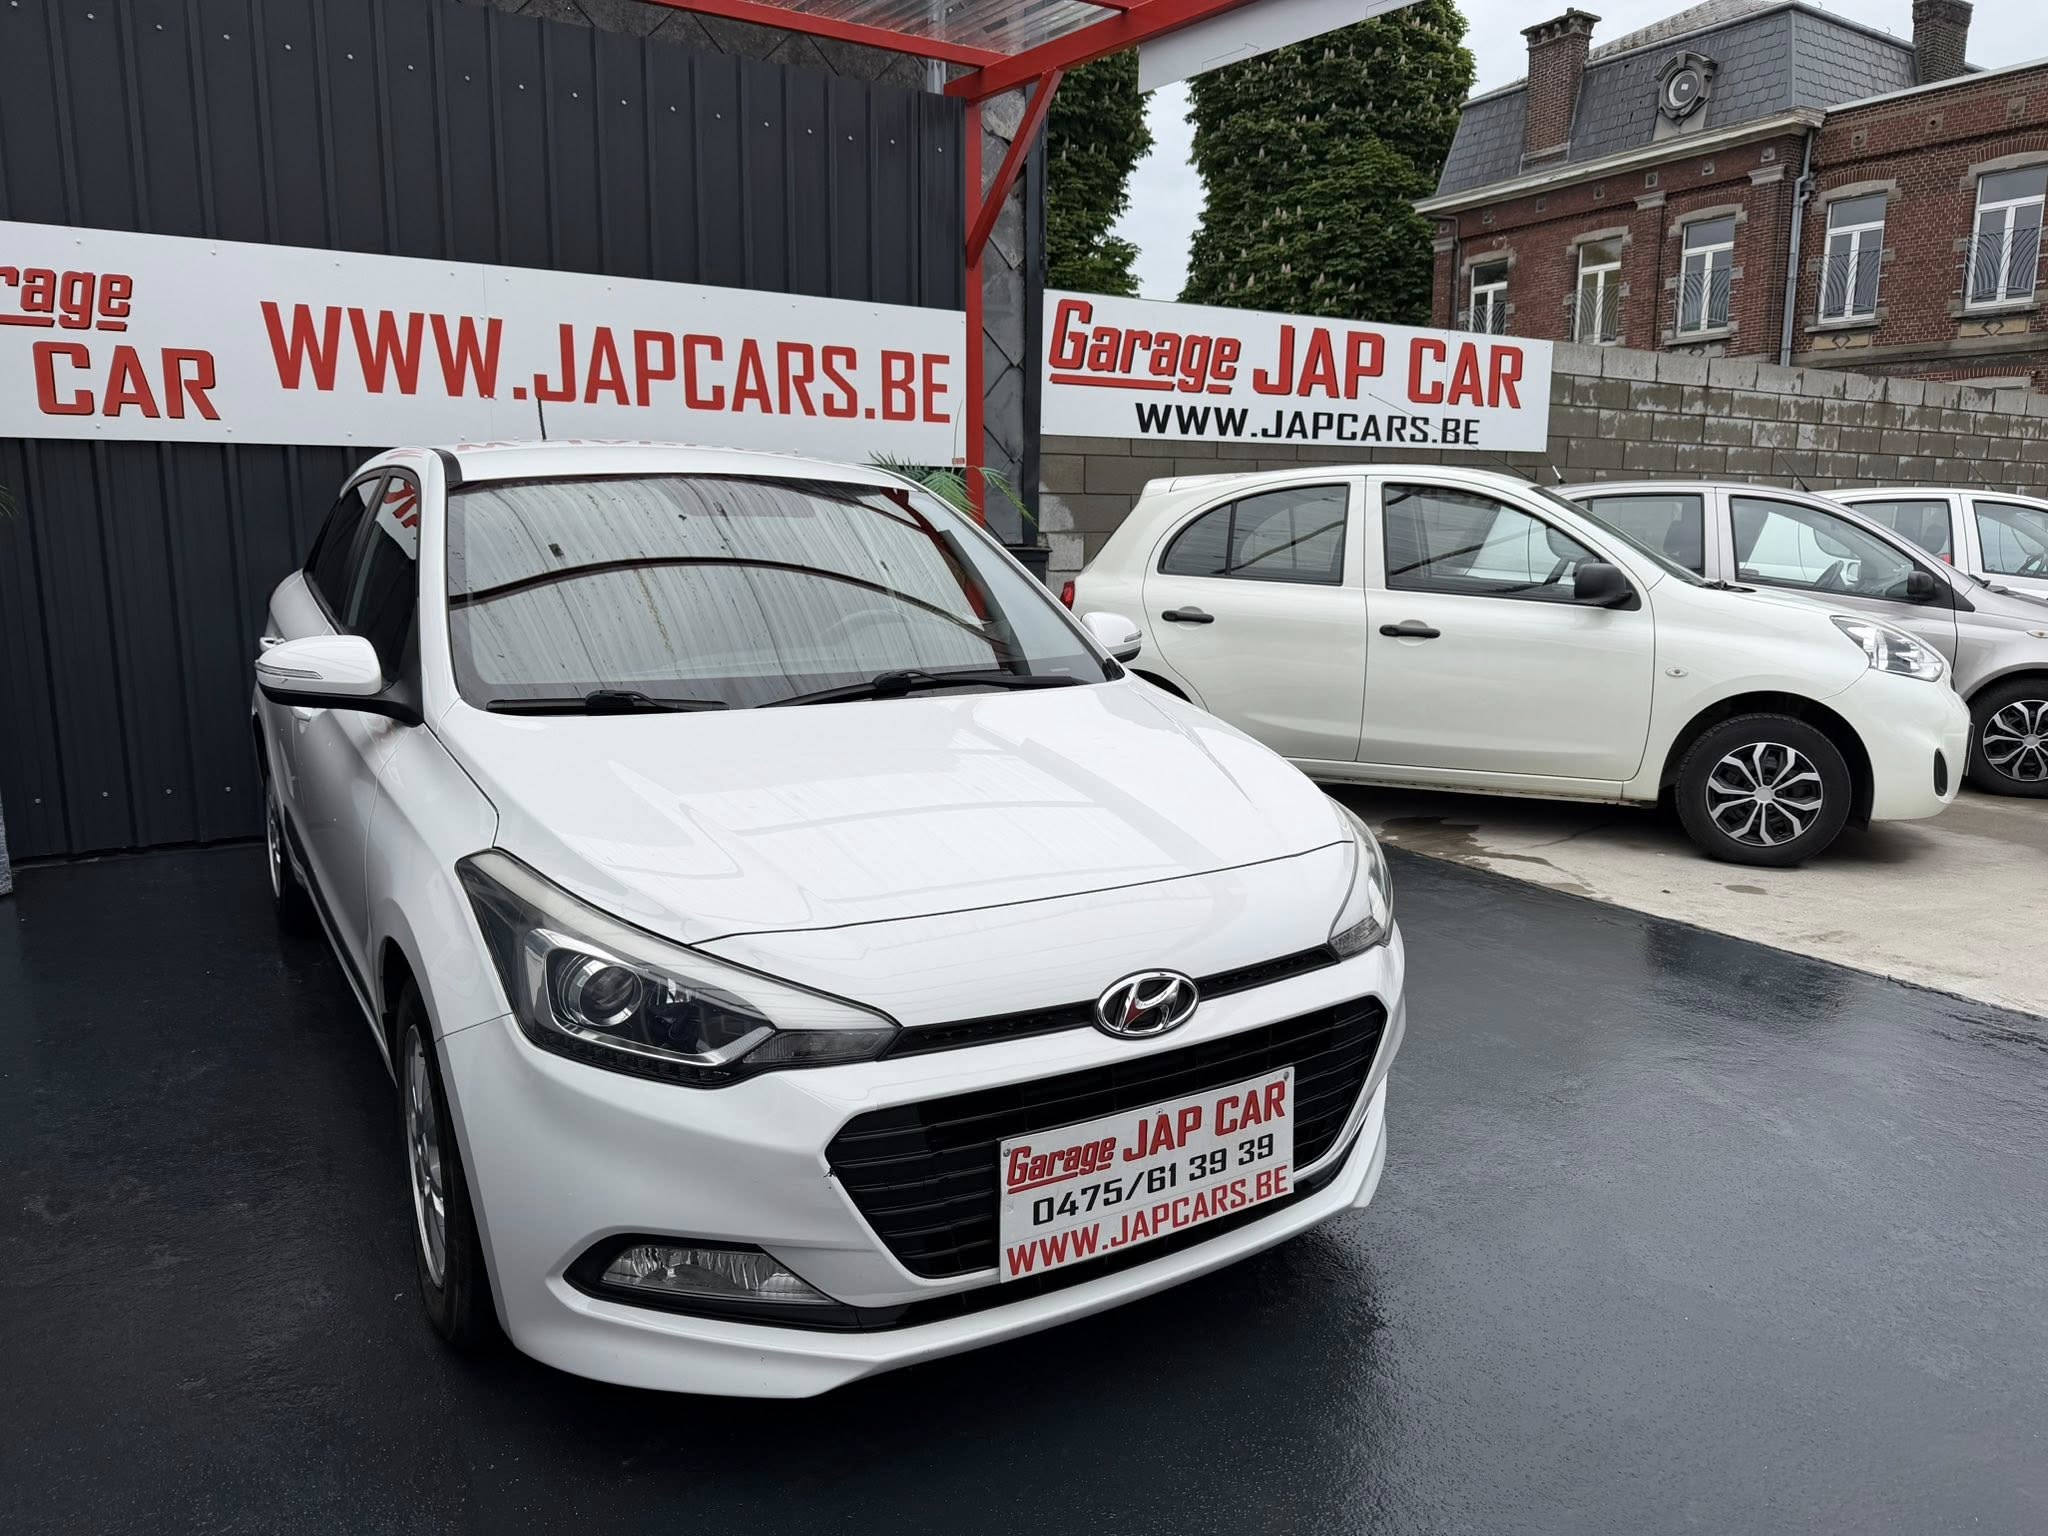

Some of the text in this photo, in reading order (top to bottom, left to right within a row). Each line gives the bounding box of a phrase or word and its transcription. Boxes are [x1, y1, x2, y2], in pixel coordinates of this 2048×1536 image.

[32, 340, 222, 421] CAR
[260, 300, 951, 424] WWW.JAPCARS.BE
[1048, 298, 1524, 410] Garage JAP CAR
[1135, 402, 1480, 445] WWW.JAPCARS.BE
[1006, 1080, 1286, 1188] Garage JAP CAR
[1032, 1133, 1274, 1226] 0475/61 39 39
[1006, 1164, 1289, 1277] WWW.JAPCARS.BE
